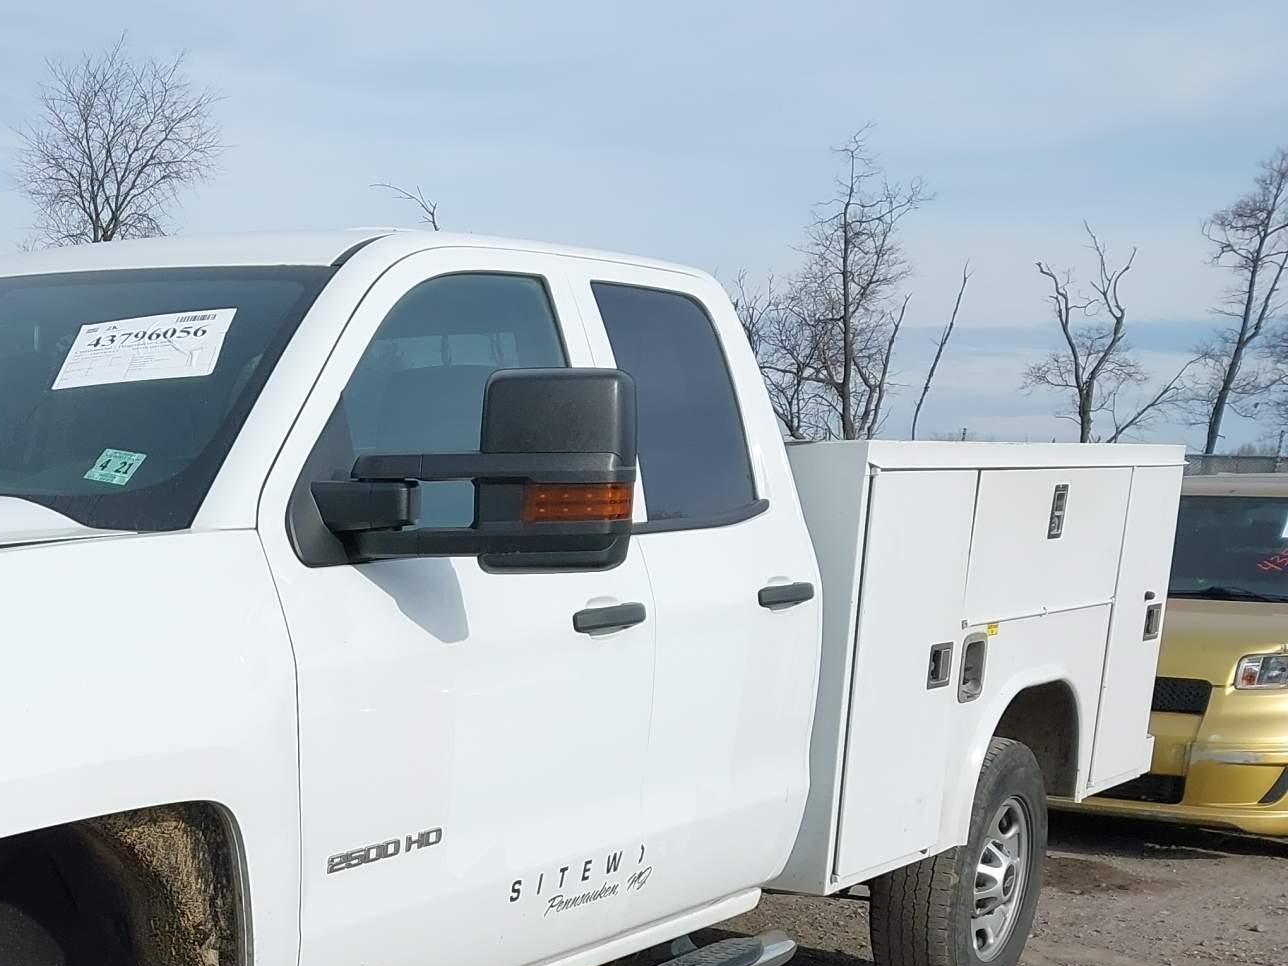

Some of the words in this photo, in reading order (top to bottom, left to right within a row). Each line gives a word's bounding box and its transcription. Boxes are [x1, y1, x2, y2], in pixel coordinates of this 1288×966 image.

[87, 324, 209, 348] 43796056
[99, 458, 112, 471] 4
[113, 460, 134, 475] 21
[326, 838, 401, 875] 2500
[405, 826, 443, 853] HD
